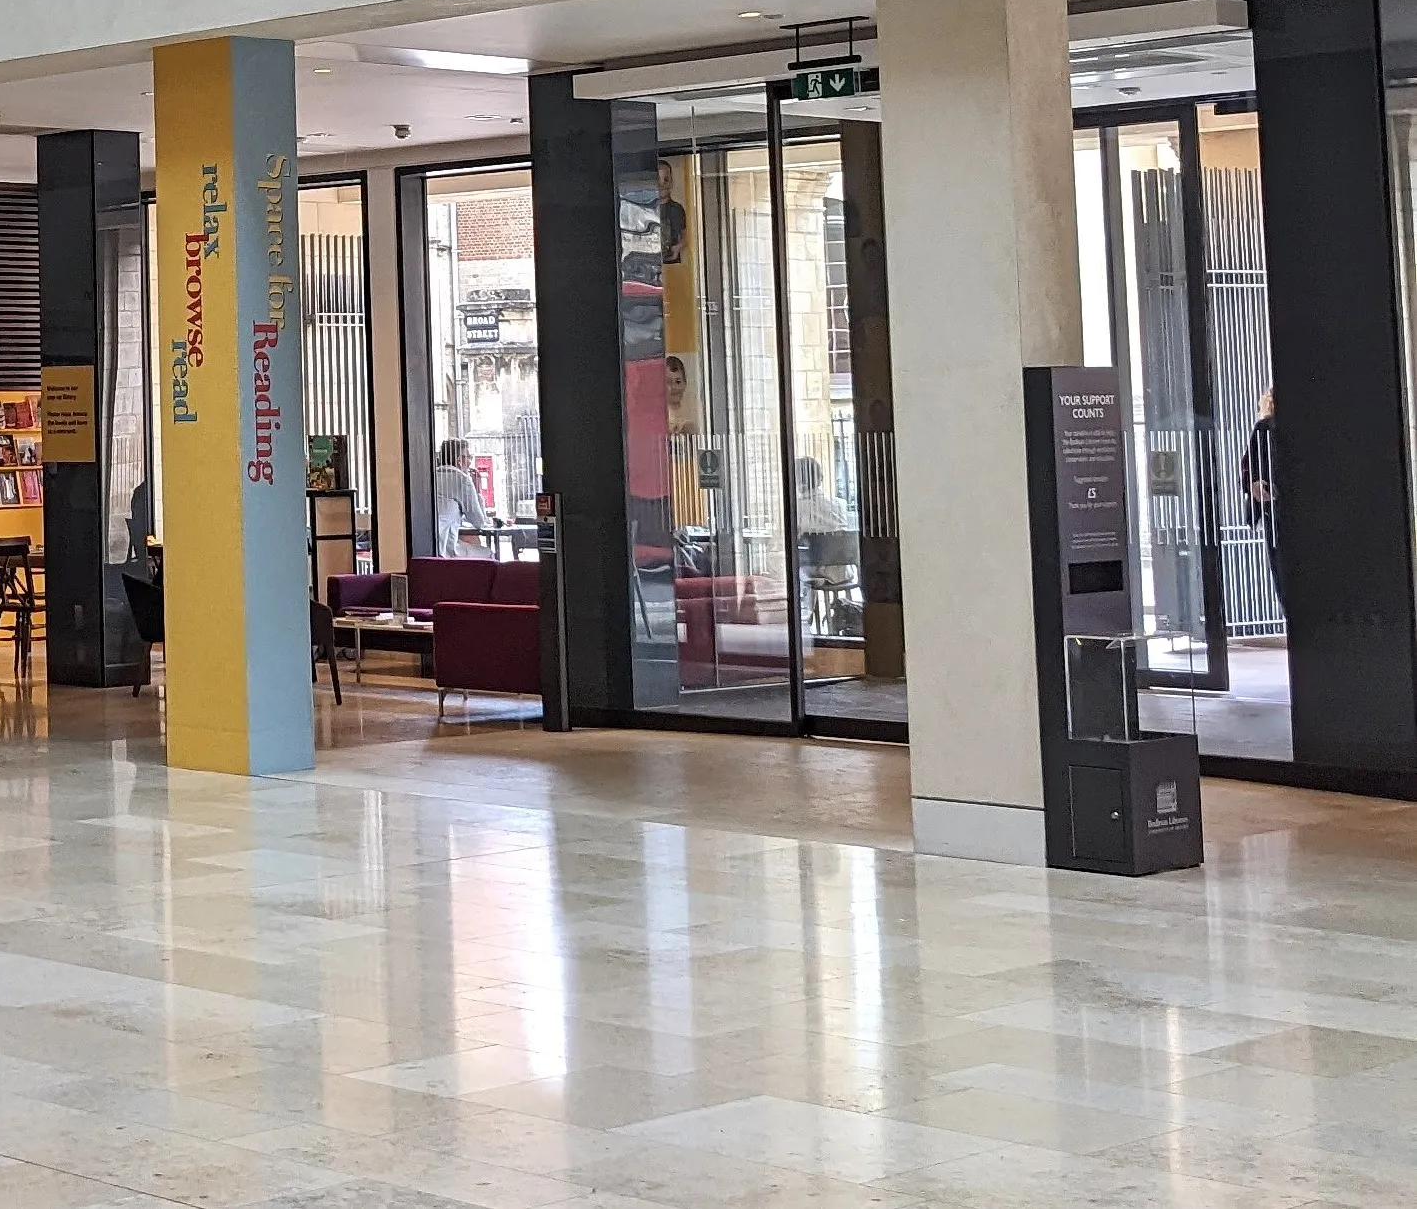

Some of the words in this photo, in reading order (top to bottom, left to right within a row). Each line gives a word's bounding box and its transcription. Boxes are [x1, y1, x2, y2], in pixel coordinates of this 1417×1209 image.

[202, 163, 228, 259] relax
[256, 153, 292, 266] Space
[185, 232, 210, 368] browse
[268, 273, 293, 330] for
[466, 316, 496, 325] BROAD
[466, 329, 499, 339] STREET
[171, 338, 198, 425] read
[247, 319, 281, 486] Reading
[1059, 395, 1081, 406] YOUR
[1082, 394, 1115, 405] SUPPORT
[1072, 408, 1104, 419] COUNTS
[1087, 487, 1097, 499] £5
